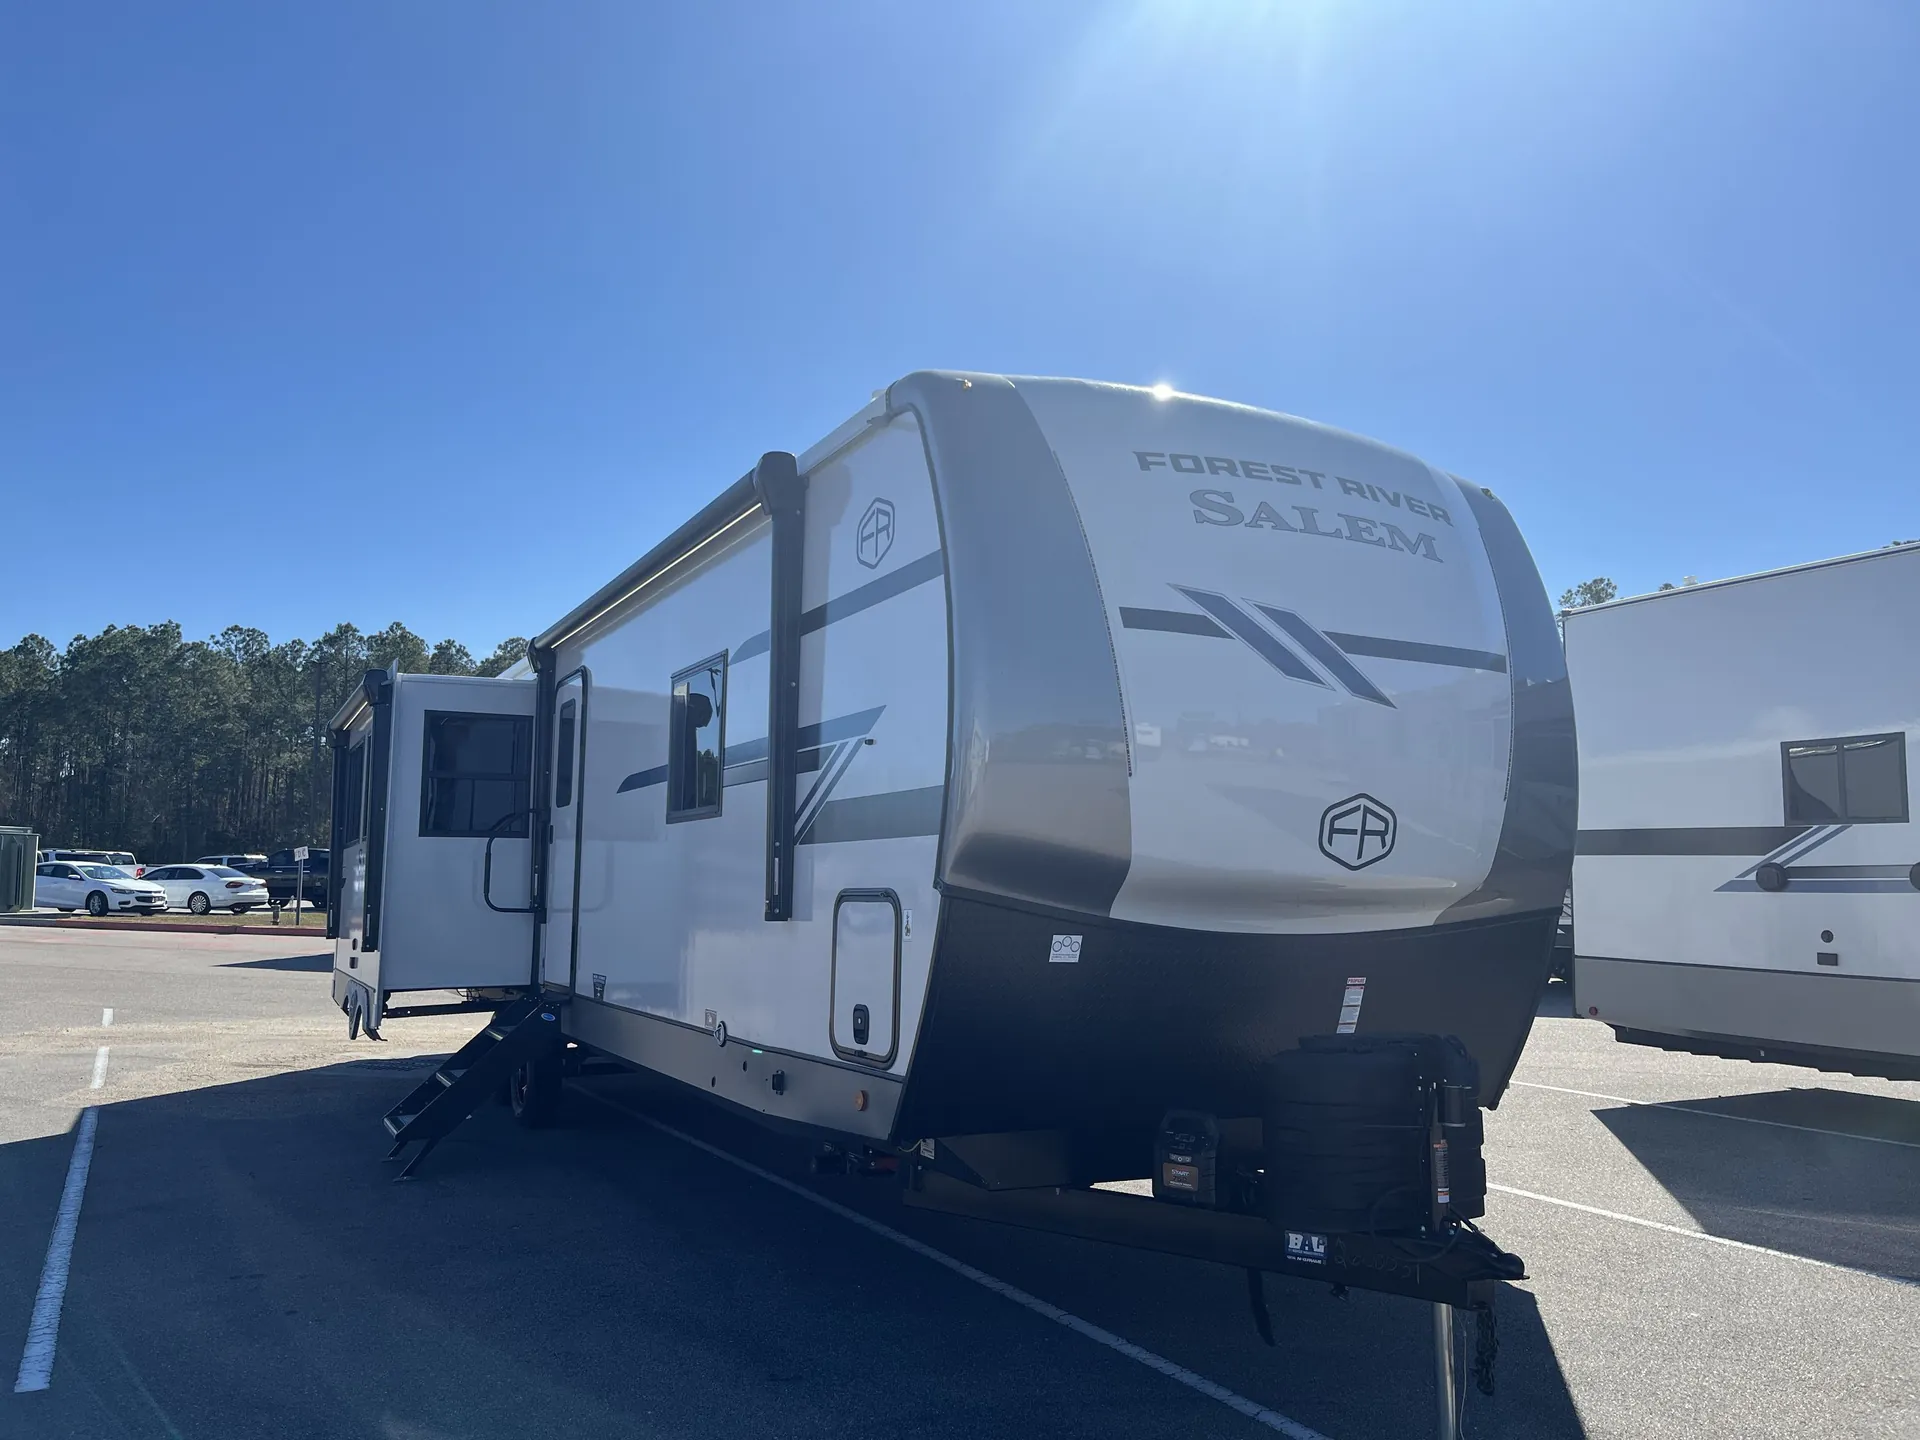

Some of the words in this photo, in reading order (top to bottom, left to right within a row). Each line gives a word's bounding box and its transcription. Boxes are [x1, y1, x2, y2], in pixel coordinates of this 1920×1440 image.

[1133, 450, 1326, 490] FOREST
[1334, 475, 1454, 528] RIVER
[1188, 488, 1445, 564] SALEM
